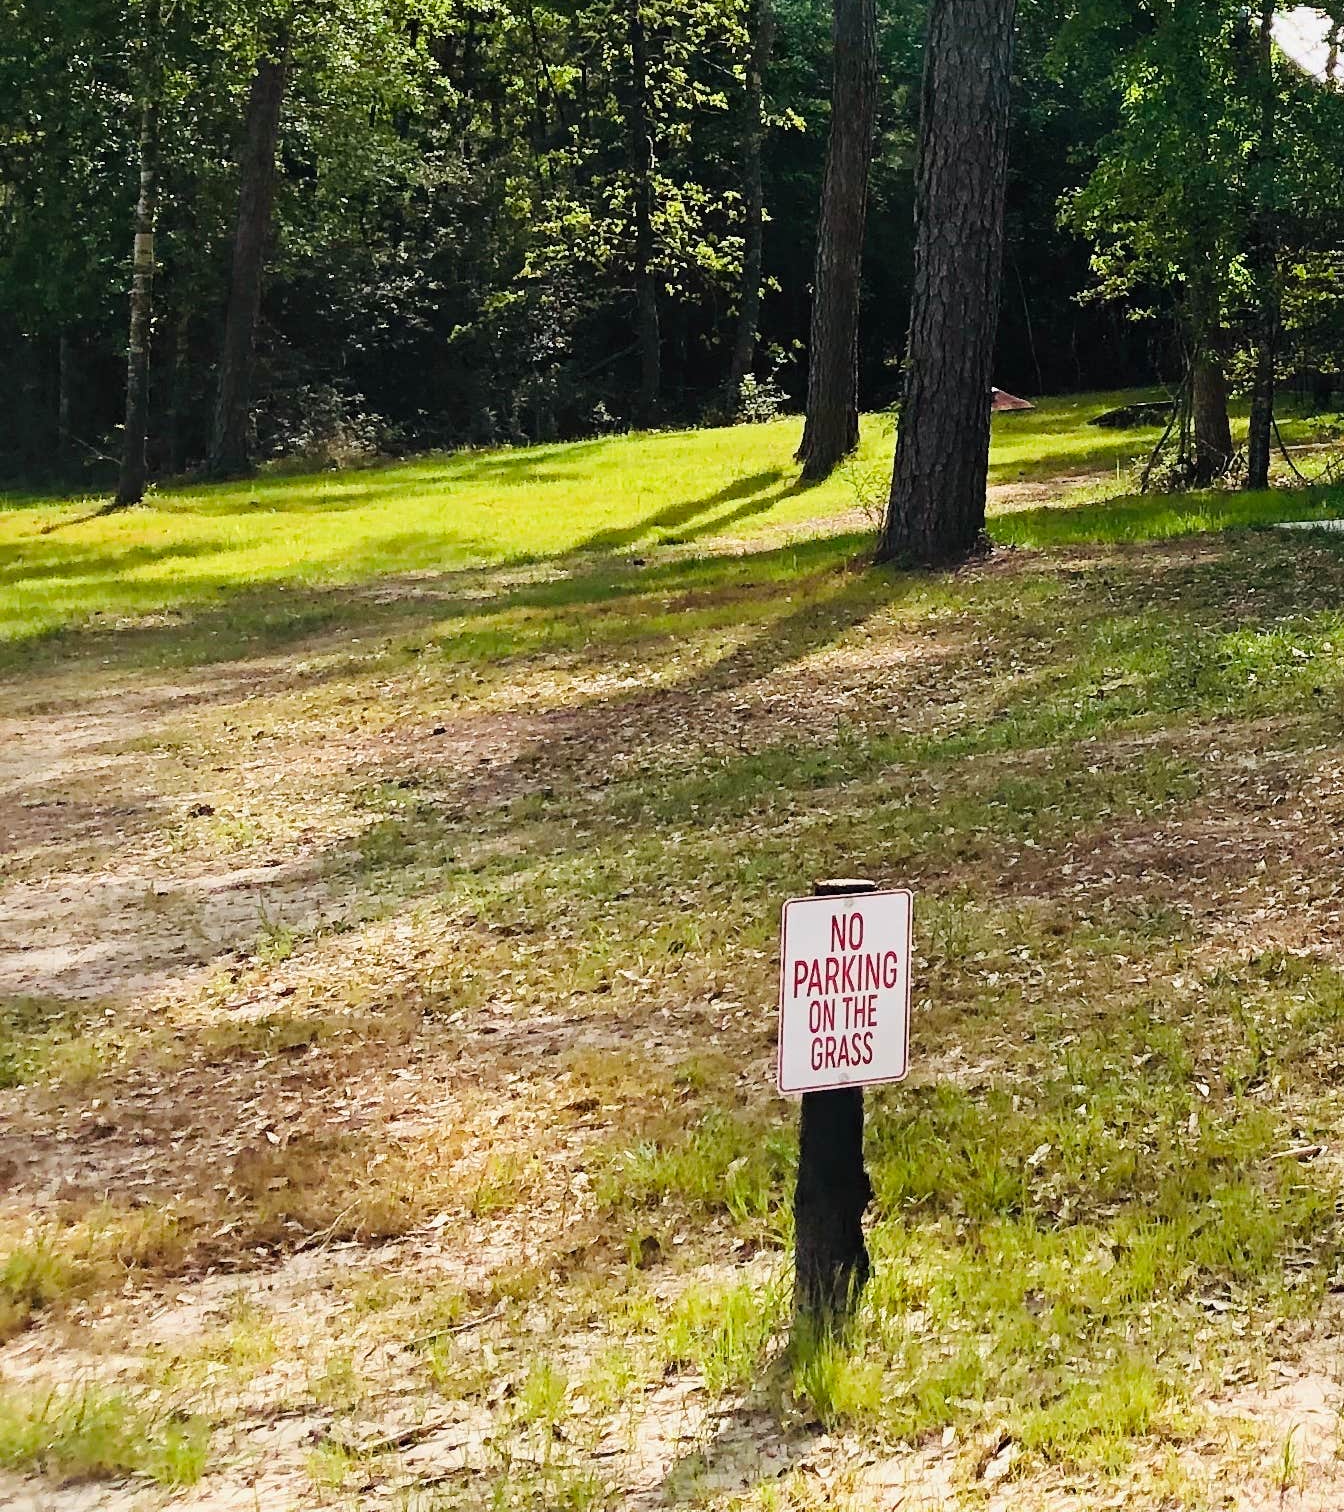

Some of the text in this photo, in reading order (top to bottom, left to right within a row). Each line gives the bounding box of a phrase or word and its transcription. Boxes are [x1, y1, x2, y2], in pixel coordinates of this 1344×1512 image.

[830, 912, 864, 953] NO
[793, 950, 898, 999] PARKING
[808, 994, 878, 1034] ON THE
[810, 1031, 874, 1071] GRASS
